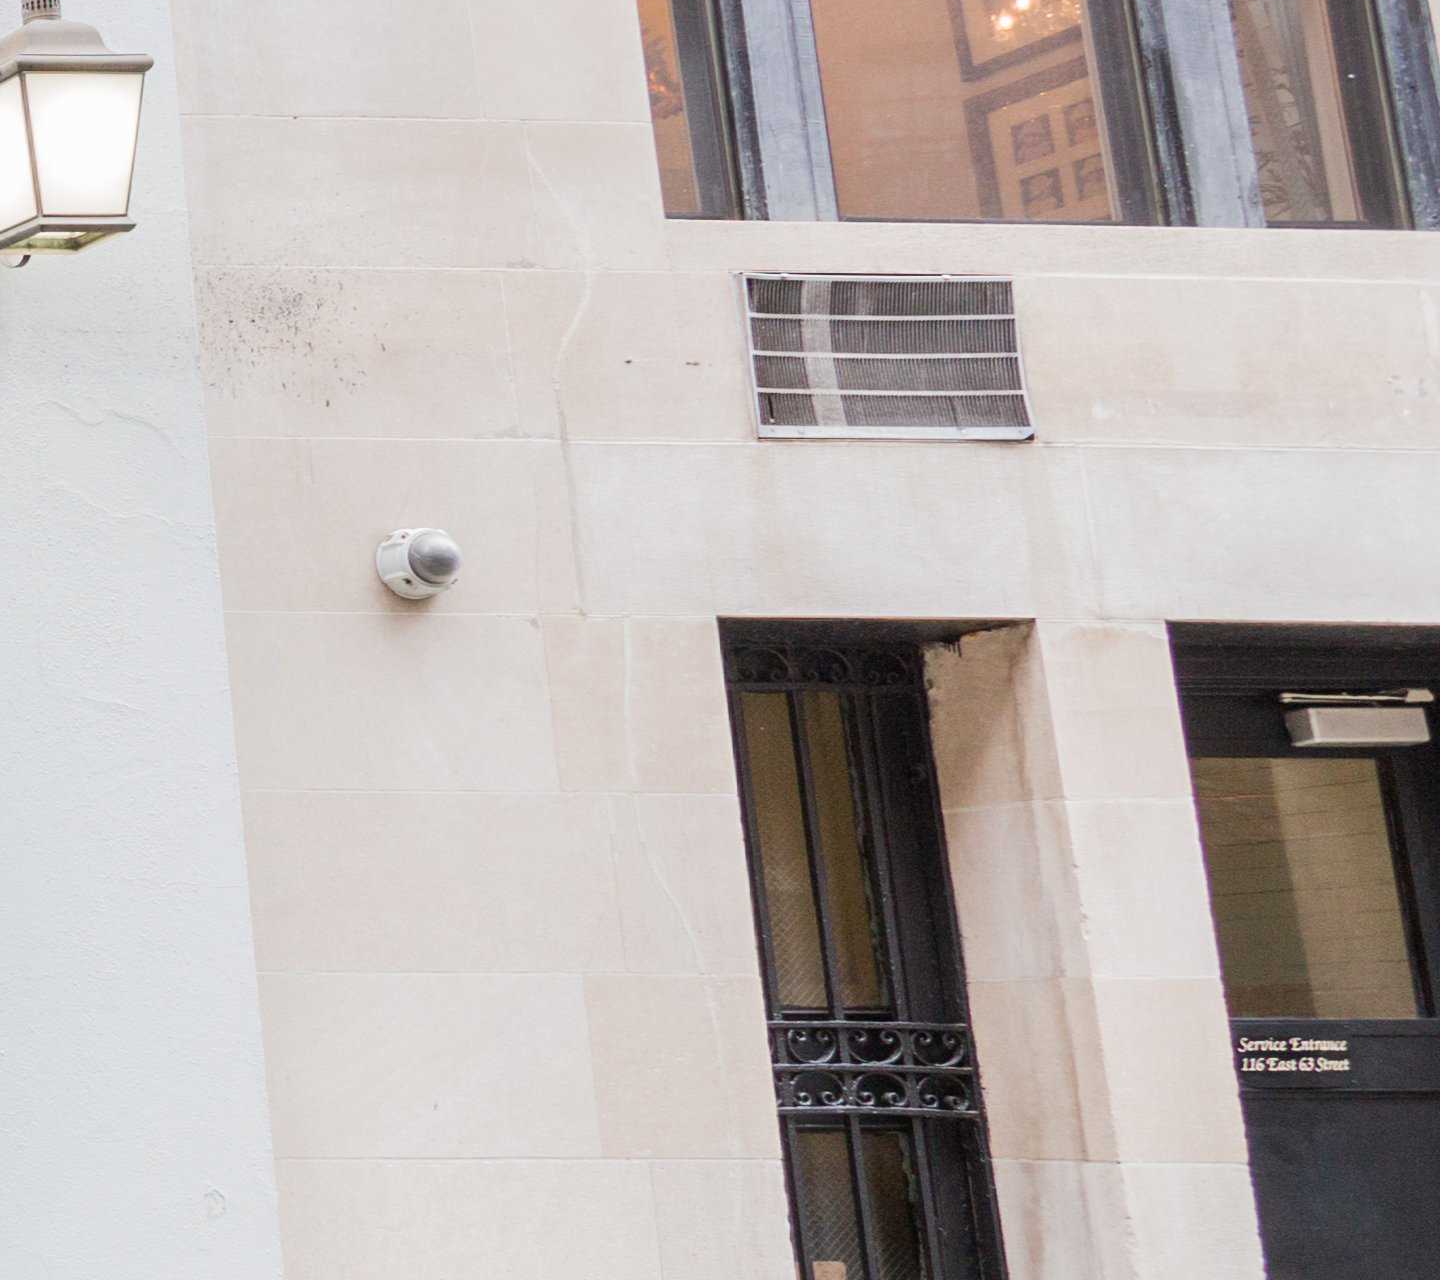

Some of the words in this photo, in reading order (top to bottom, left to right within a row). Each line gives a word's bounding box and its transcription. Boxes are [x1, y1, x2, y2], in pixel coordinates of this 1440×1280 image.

[1237, 1037, 1288, 1052] Service
[1289, 1037, 1348, 1051] Entrance
[1241, 1057, 1265, 1071] 116
[1266, 1058, 1297, 1071] East
[1299, 1057, 1315, 1072] 63
[1315, 1057, 1351, 1072] Street
